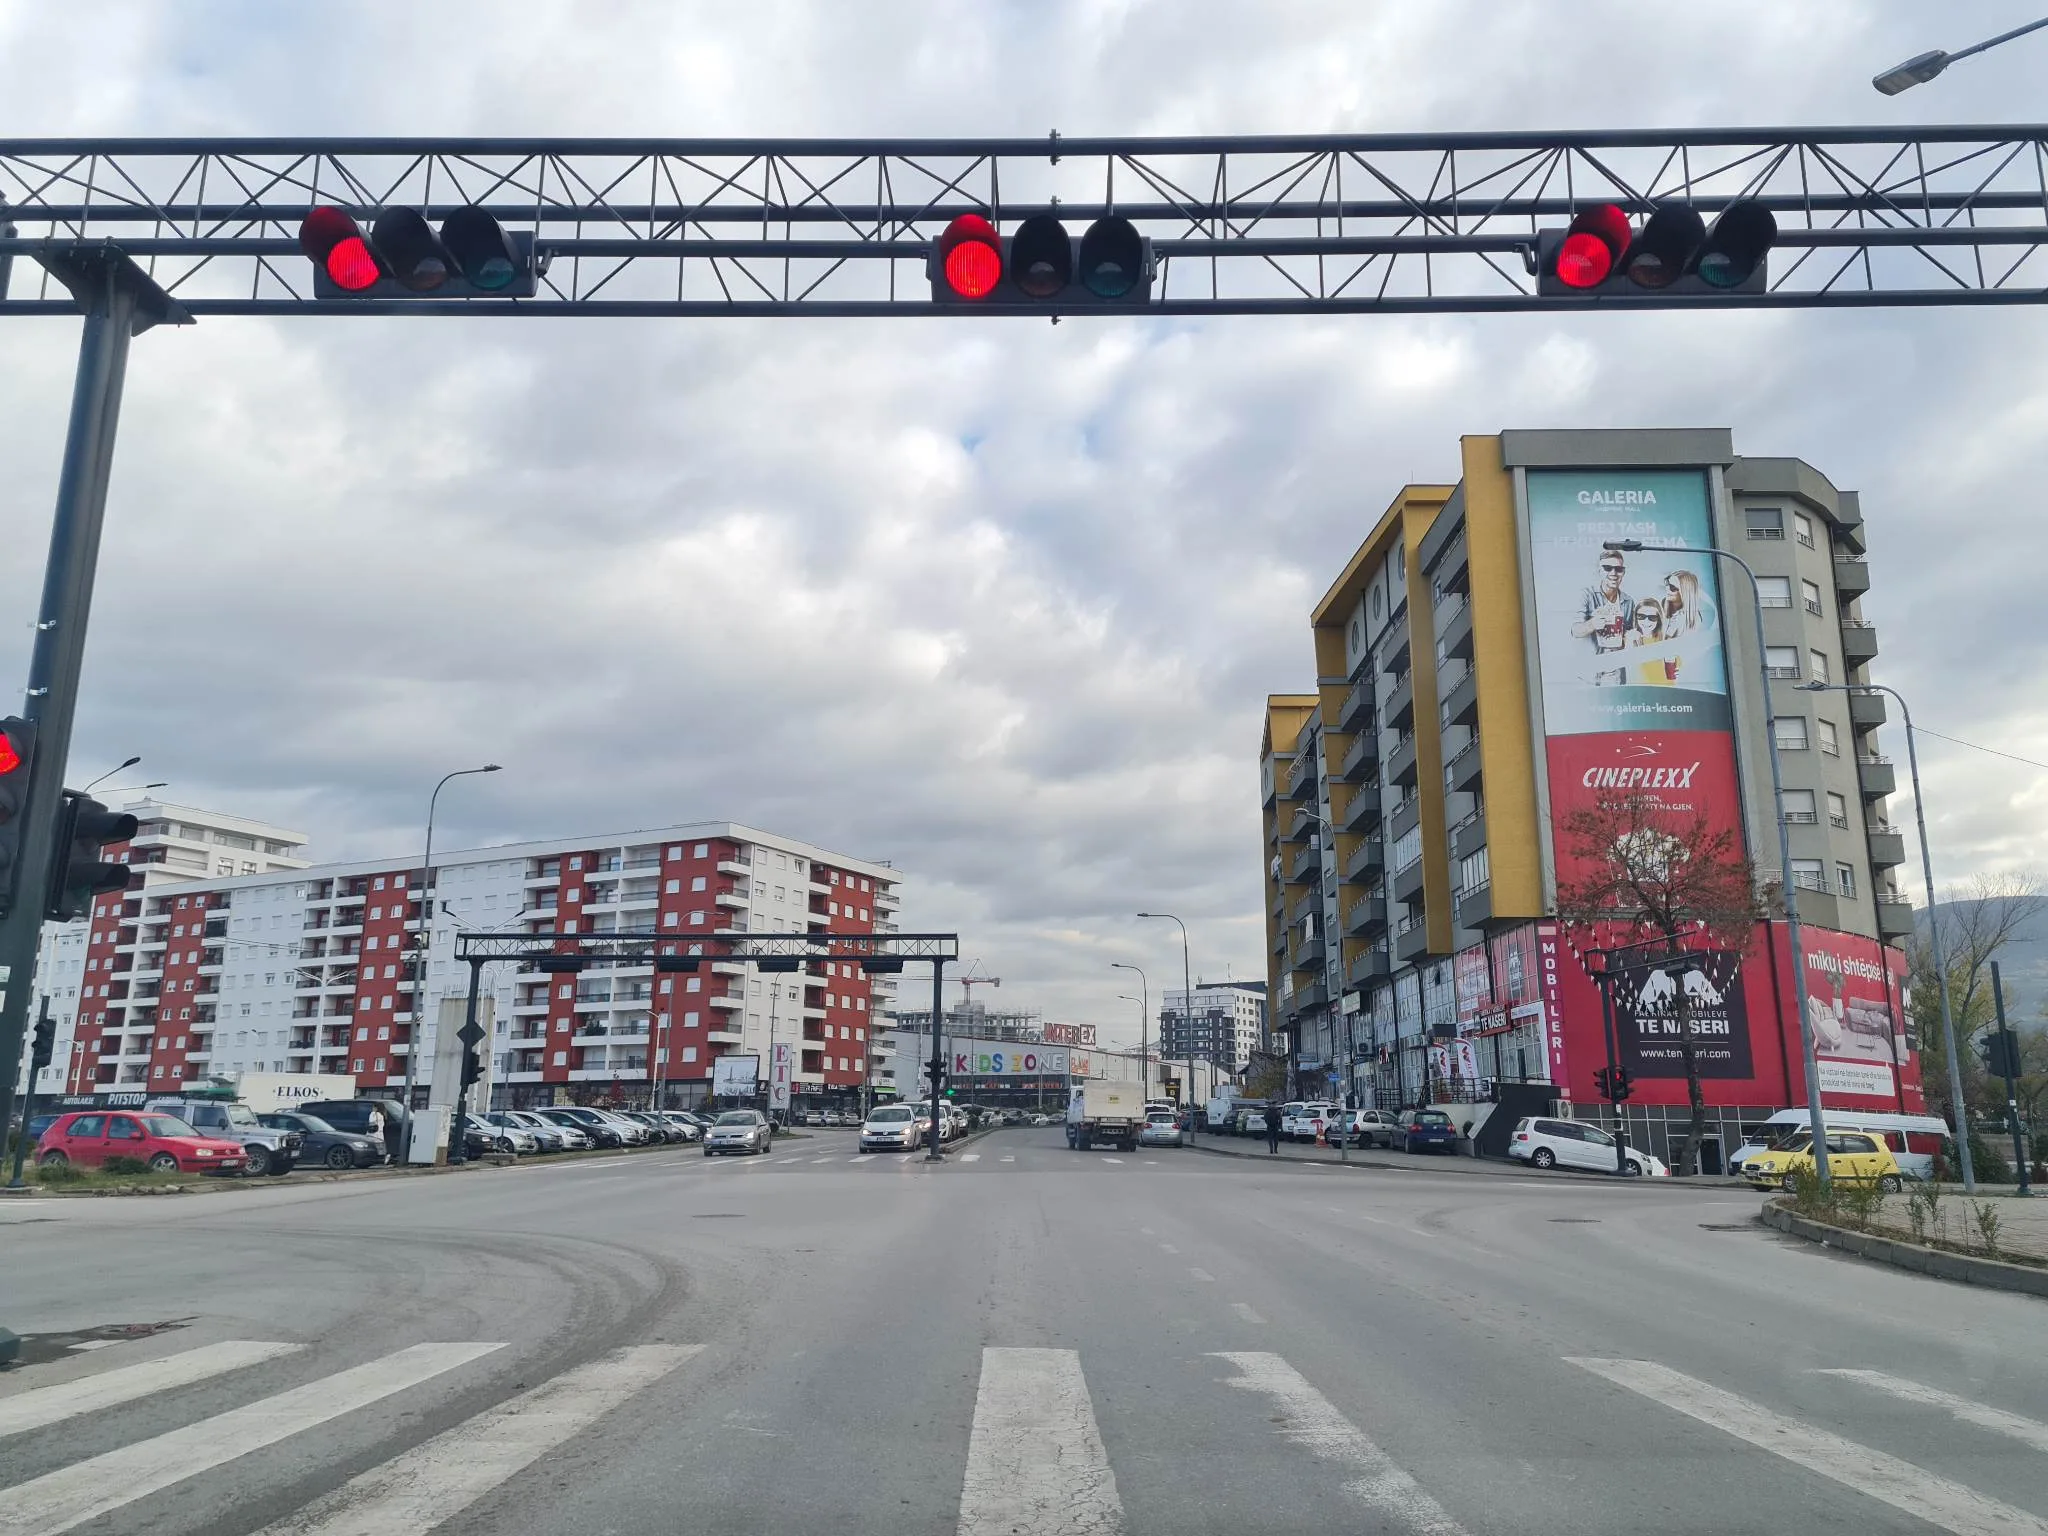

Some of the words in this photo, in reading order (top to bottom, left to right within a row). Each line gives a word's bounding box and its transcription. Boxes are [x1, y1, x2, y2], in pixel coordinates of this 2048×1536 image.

[1577, 490, 1656, 504] GALERIA
[1577, 522, 1615, 535] PREJ
[1617, 522, 1656, 536] TASH
[1590, 702, 1693, 715] www.galeria-ks.com
[1582, 762, 1700, 788] CINEPLEXX
[1807, 950, 1836, 973] miku
[1837, 953, 1842, 973] i
[1542, 942, 1563, 1065] MOBILERI
[1635, 1019, 1659, 1034] TE
[955, 1053, 1003, 1073] KIDS
[1011, 1053, 1065, 1072] ZONE
[277, 1086, 320, 1097] ELKOS
[107, 1093, 147, 1105] PITSTOP
